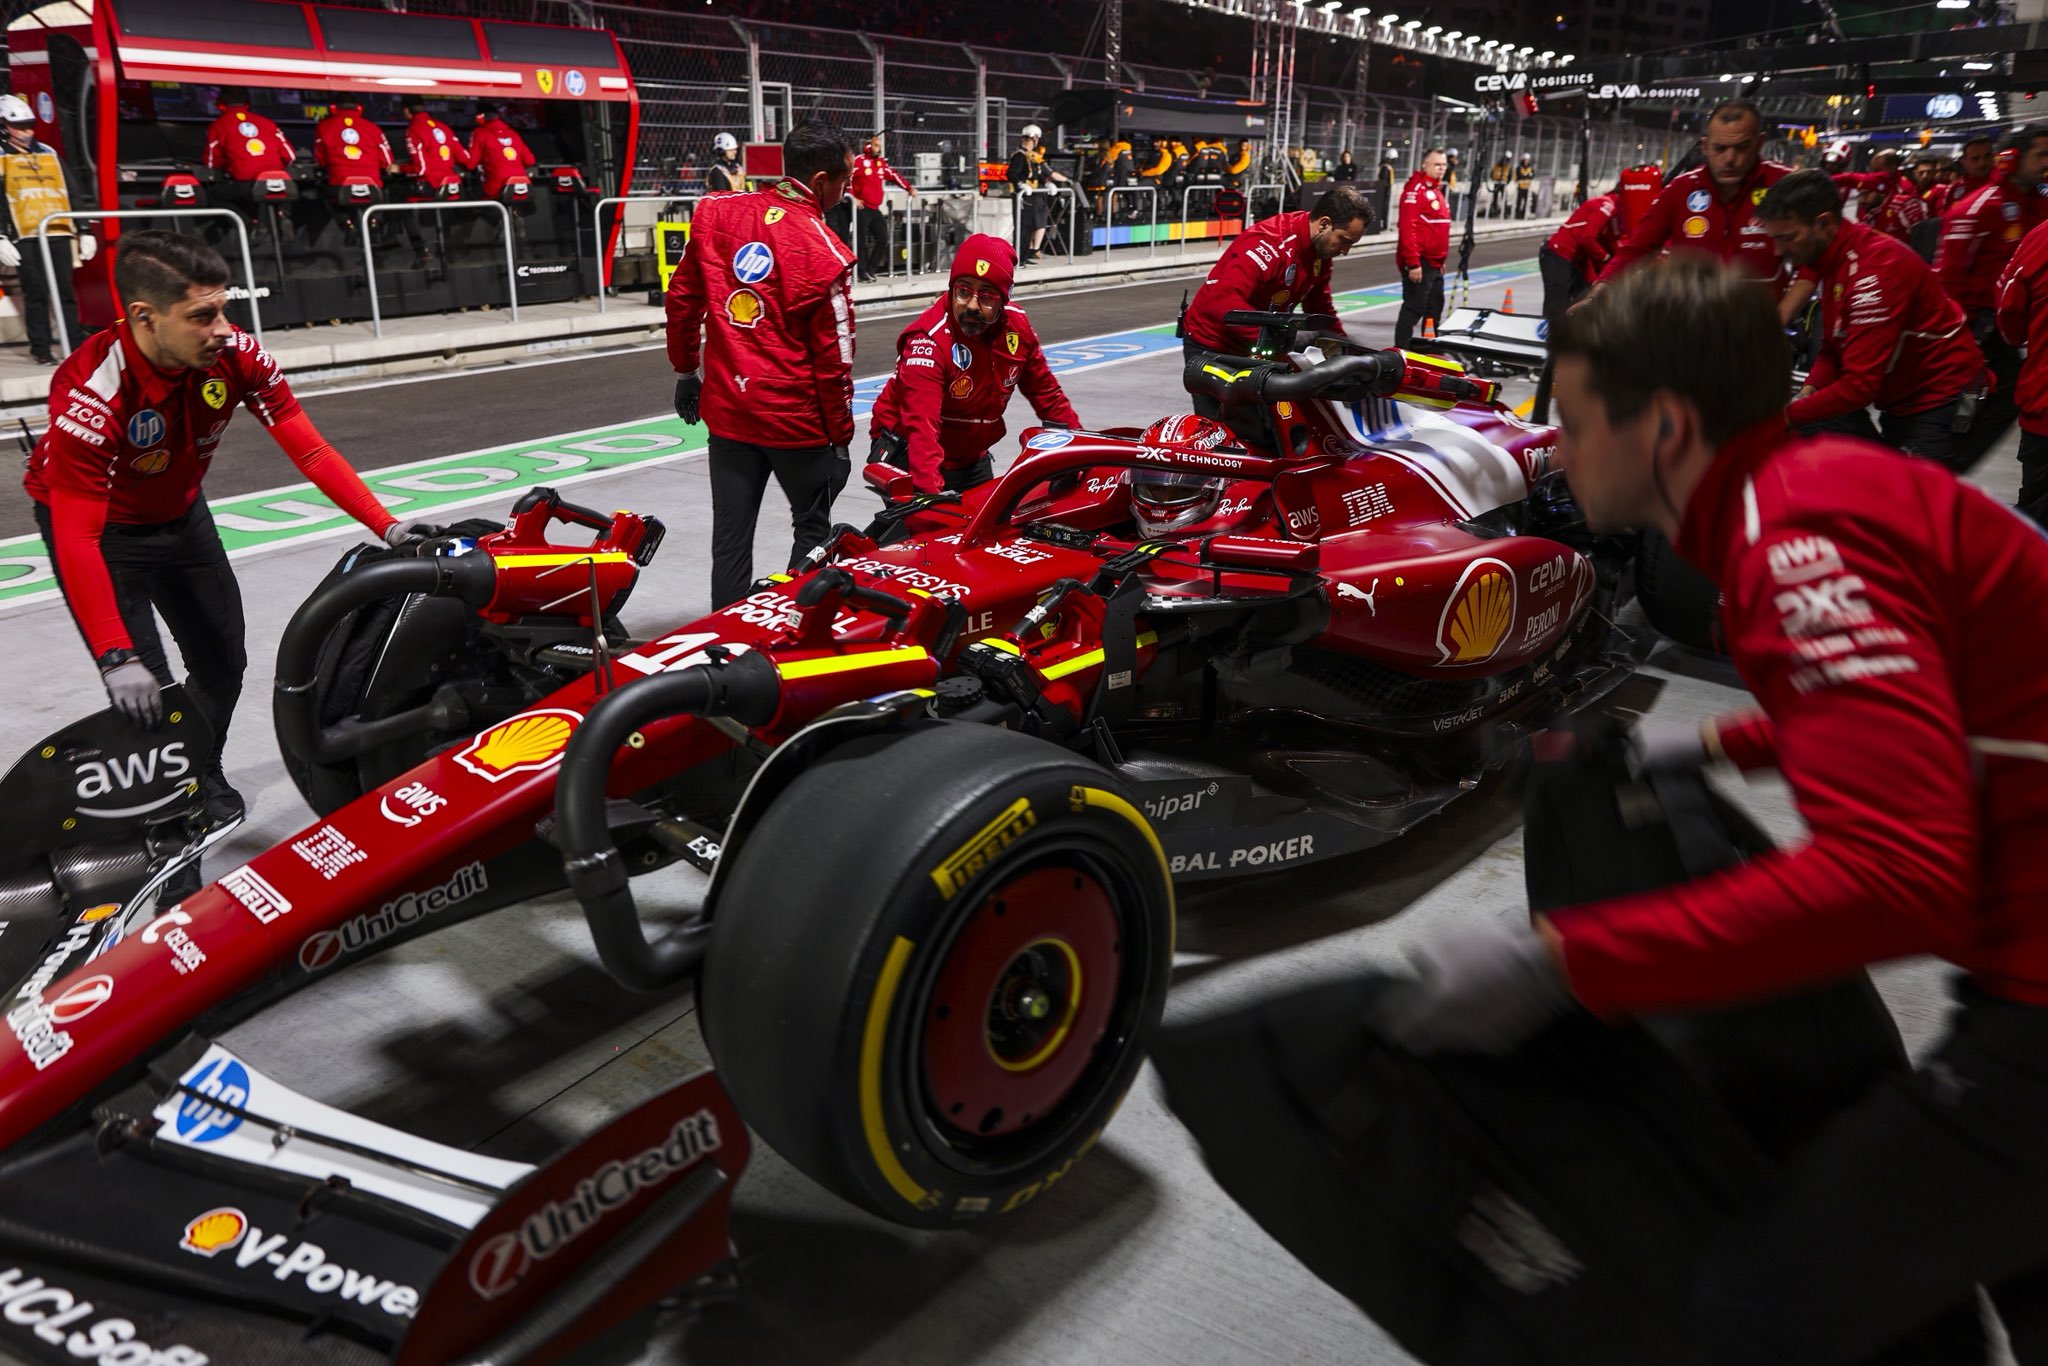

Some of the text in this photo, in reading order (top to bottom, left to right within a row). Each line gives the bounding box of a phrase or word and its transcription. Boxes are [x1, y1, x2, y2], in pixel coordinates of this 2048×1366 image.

[1532, 73, 1594, 88] LOGISTICS
[1642, 87, 1700, 98] OGISTICS
[735, 248, 772, 283] hp
[911, 345, 934, 356] ZCG
[66, 402, 106, 430] ZCG
[133, 411, 162, 447] hp
[1136, 445, 1243, 469] DXC TECHNOLOGY
[1289, 505, 1319, 529] aws
[1342, 482, 1396, 527] IBM
[1063, 532, 1071, 541] 16
[852, 560, 971, 600] GENESYS
[1524, 601, 1560, 641] PERONI
[1499, 680, 1524, 704] SKF
[75, 742, 190, 799] aws
[393, 780, 447, 818] aws
[291, 824, 368, 880] IBM
[930, 797, 1037, 900] PIRELLI
[1229, 834, 1314, 868] POKER
[218, 864, 292, 924] PIRELLI
[338, 861, 488, 953] UniCredit
[164, 926, 207, 972] CELSIUS
[6, 996, 74, 1071] UniCredit
[181, 1057, 248, 1143] hp
[518, 1108, 723, 1263] UniCredit
[235, 1227, 418, 1319] V-Powe
